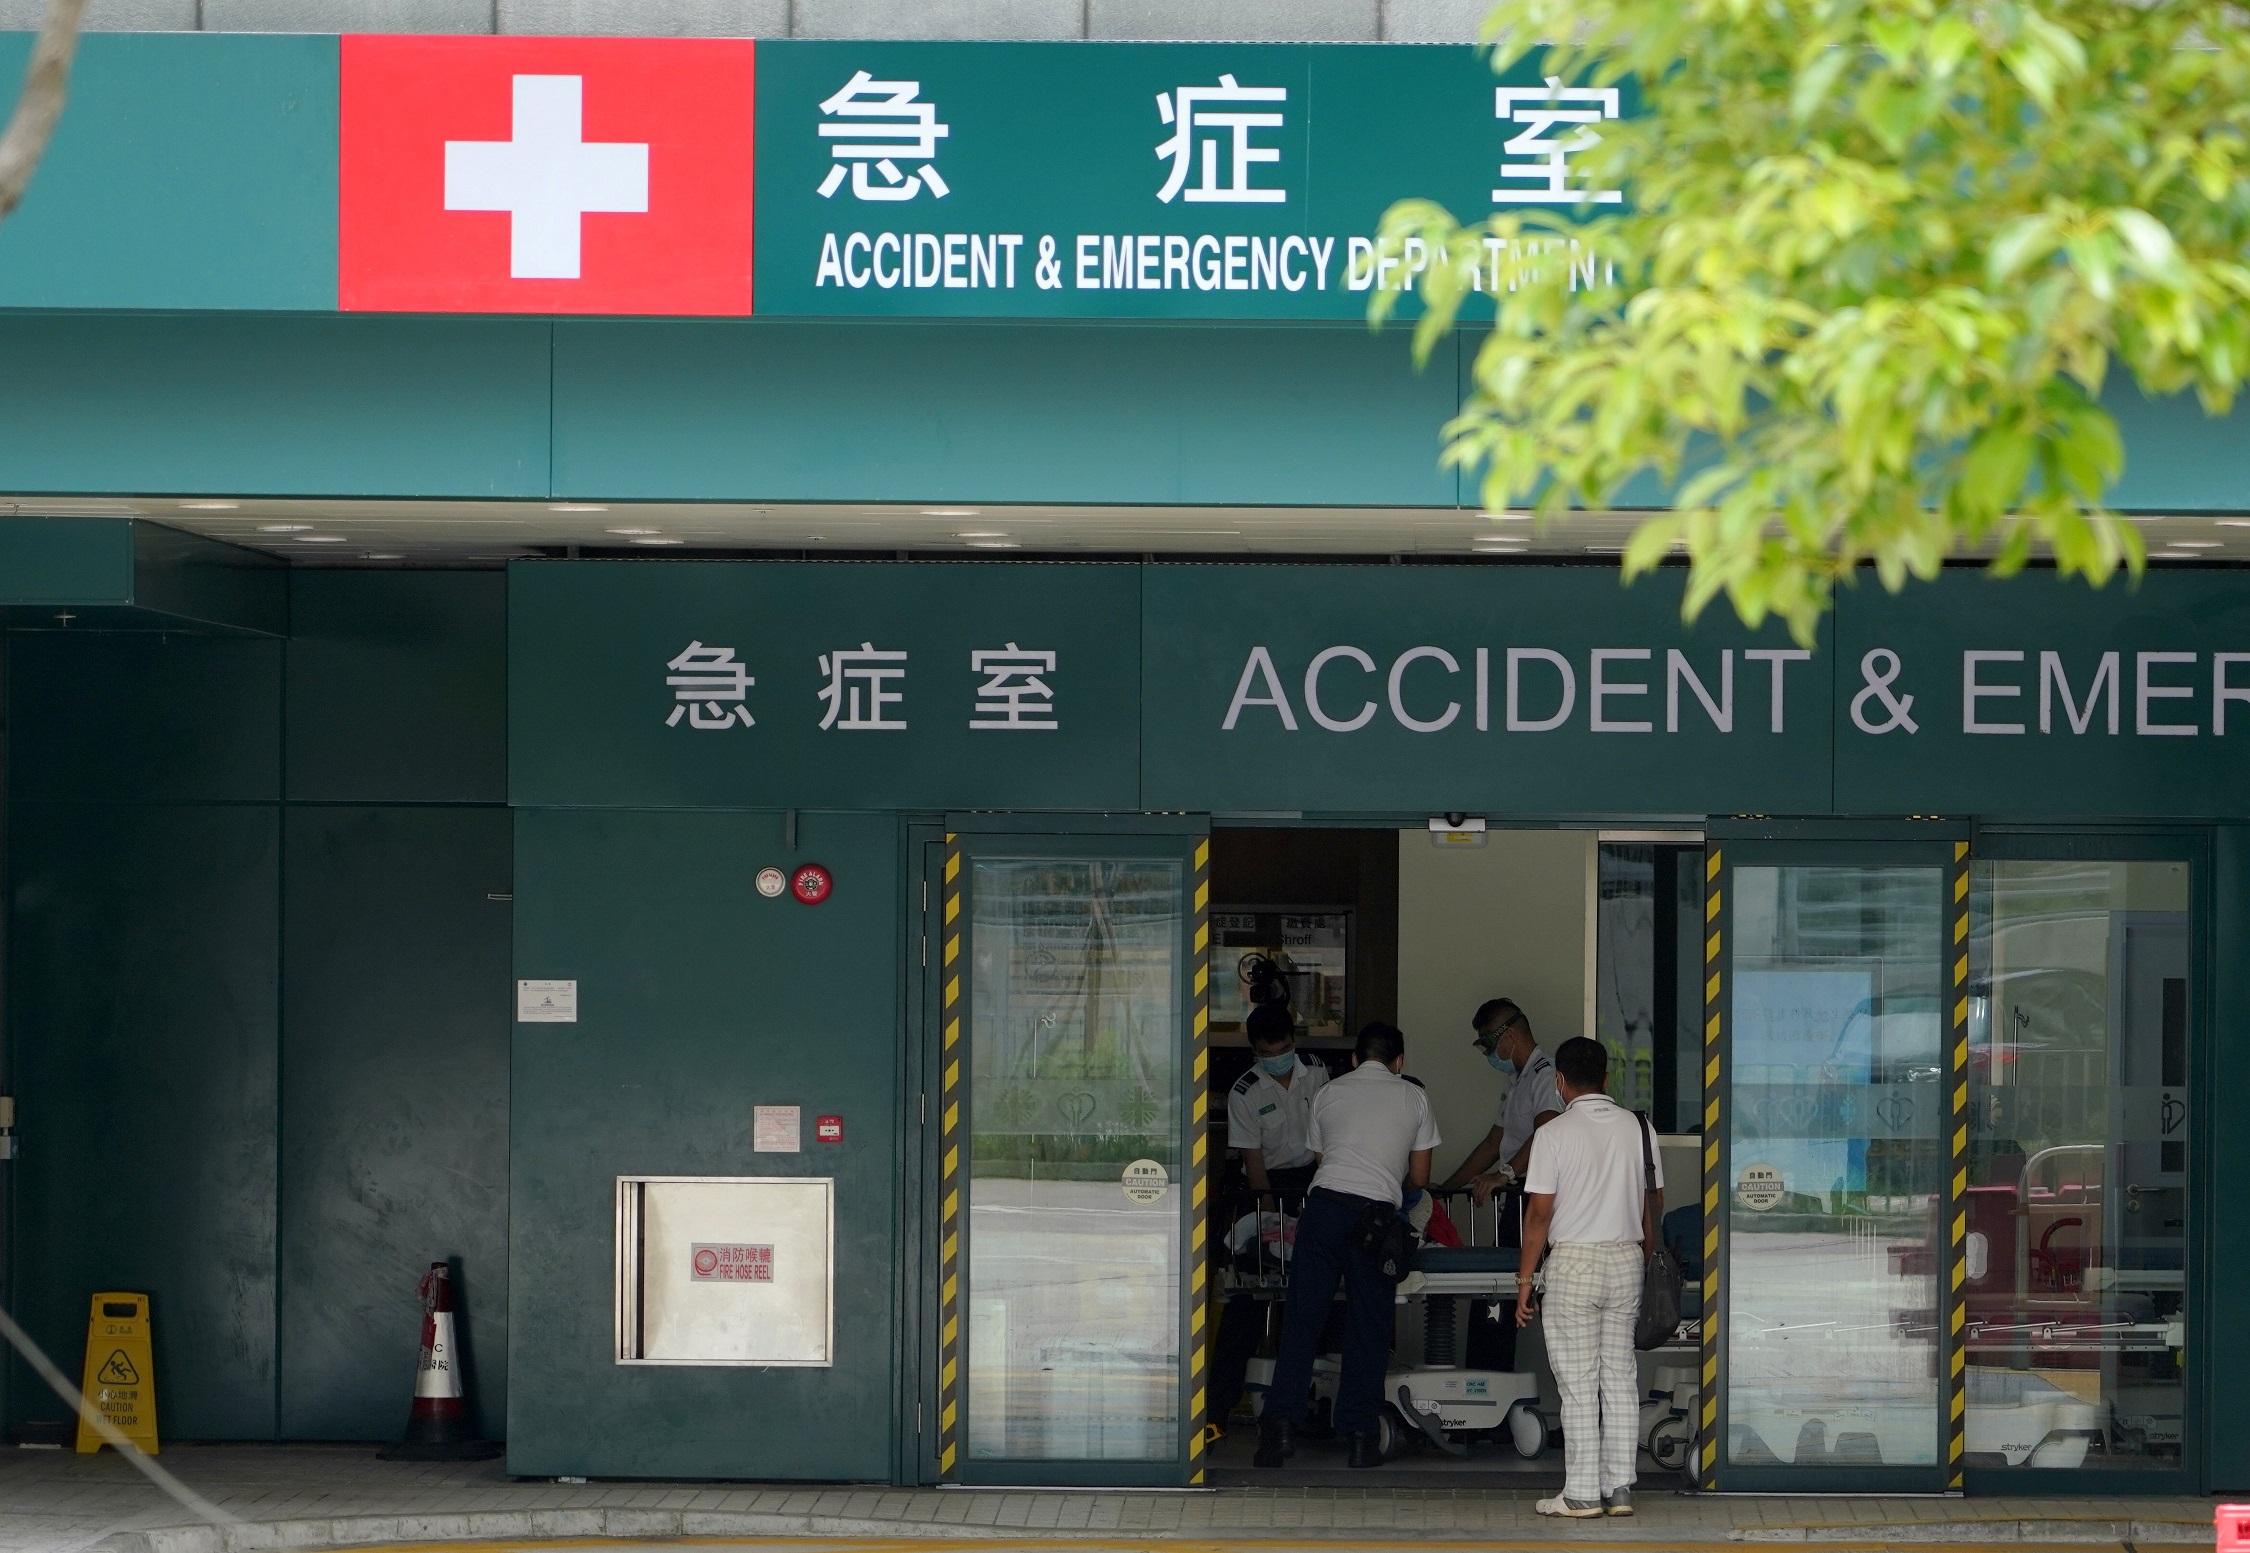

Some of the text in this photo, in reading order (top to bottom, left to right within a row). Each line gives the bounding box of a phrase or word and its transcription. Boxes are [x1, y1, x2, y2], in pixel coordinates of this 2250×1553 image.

[816, 70, 1623, 205] 急症室
[815, 232, 1622, 294] ACCIDENT & EMERGENCY DEPRTMN
[665, 639, 1058, 731] 急症室
[1221, 646, 2250, 736] ACCIDENT & EMER
[1125, 1178, 1165, 1187] CAUTION
[1741, 1183, 1781, 1191] CAUTION
[720, 1264, 771, 1280] FIRE HOSE REEL
[100, 1402, 134, 1413] CAUTION
[113, 1415, 138, 1426] FLOOR
[2001, 1443, 2033, 1452] stryker
